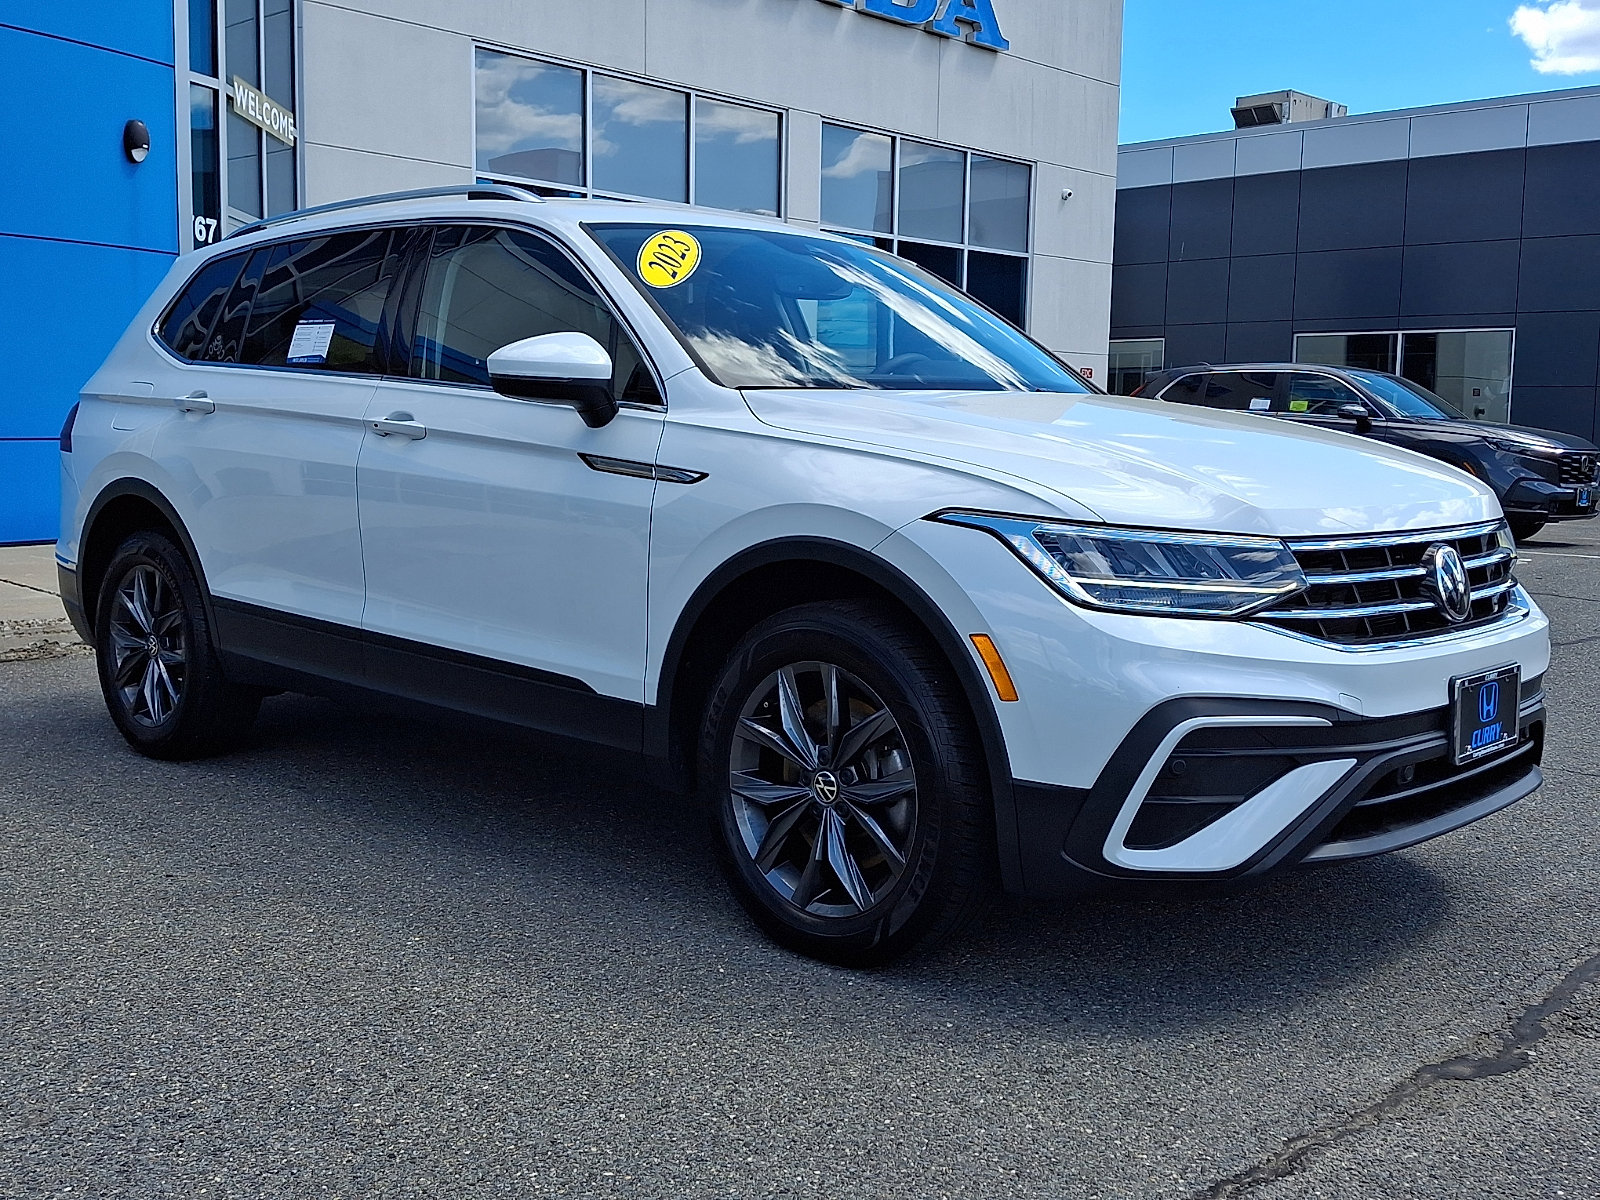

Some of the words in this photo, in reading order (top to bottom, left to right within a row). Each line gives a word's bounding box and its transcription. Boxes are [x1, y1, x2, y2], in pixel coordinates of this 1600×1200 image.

[234, 81, 294, 141] WELCOME
[192, 214, 218, 244] 67
[648, 235, 691, 280] 2023
[1471, 721, 1503, 749] CURRY
